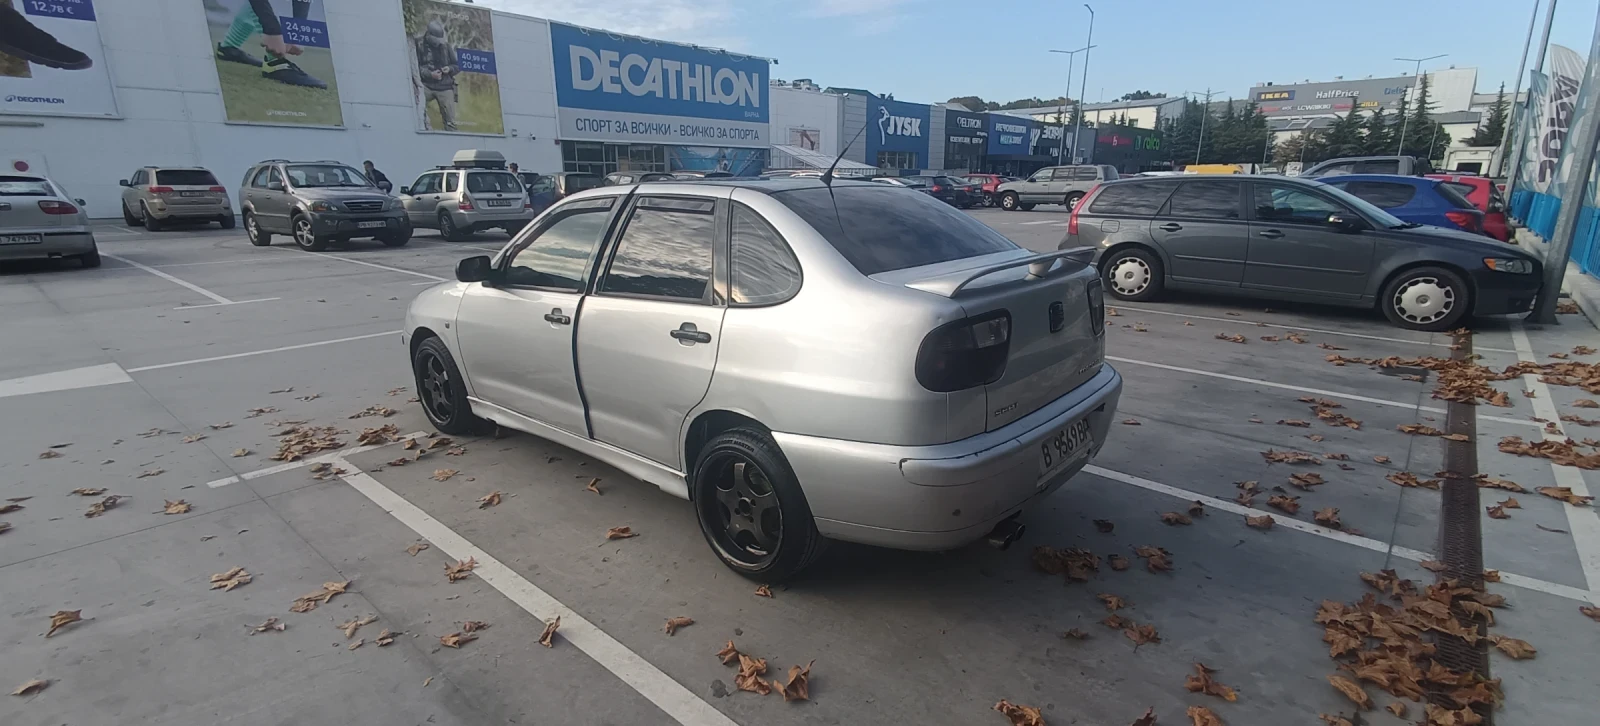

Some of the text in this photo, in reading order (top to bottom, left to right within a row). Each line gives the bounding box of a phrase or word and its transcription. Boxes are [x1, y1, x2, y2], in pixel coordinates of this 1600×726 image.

[31, 1, 64, 13] 12,78
[286, 22, 310, 32] 24,99
[287, 32, 310, 42] 12,78
[462, 53, 480, 62] 40,99
[569, 44, 760, 108] DECATHLON
[1316, 89, 1360, 99] HalfPrice
[17, 96, 64, 104] DECATHLON
[576, 118, 612, 132] СПОРТ
[615, 120, 629, 134] ЗА
[631, 122, 671, 136] ВСИЧКИ
[680, 124, 714, 138] ВСИЧКО
[717, 127, 728, 138] ЗА
[729, 128, 759, 140] СПОРТА
[887, 116, 922, 137] JYSK
